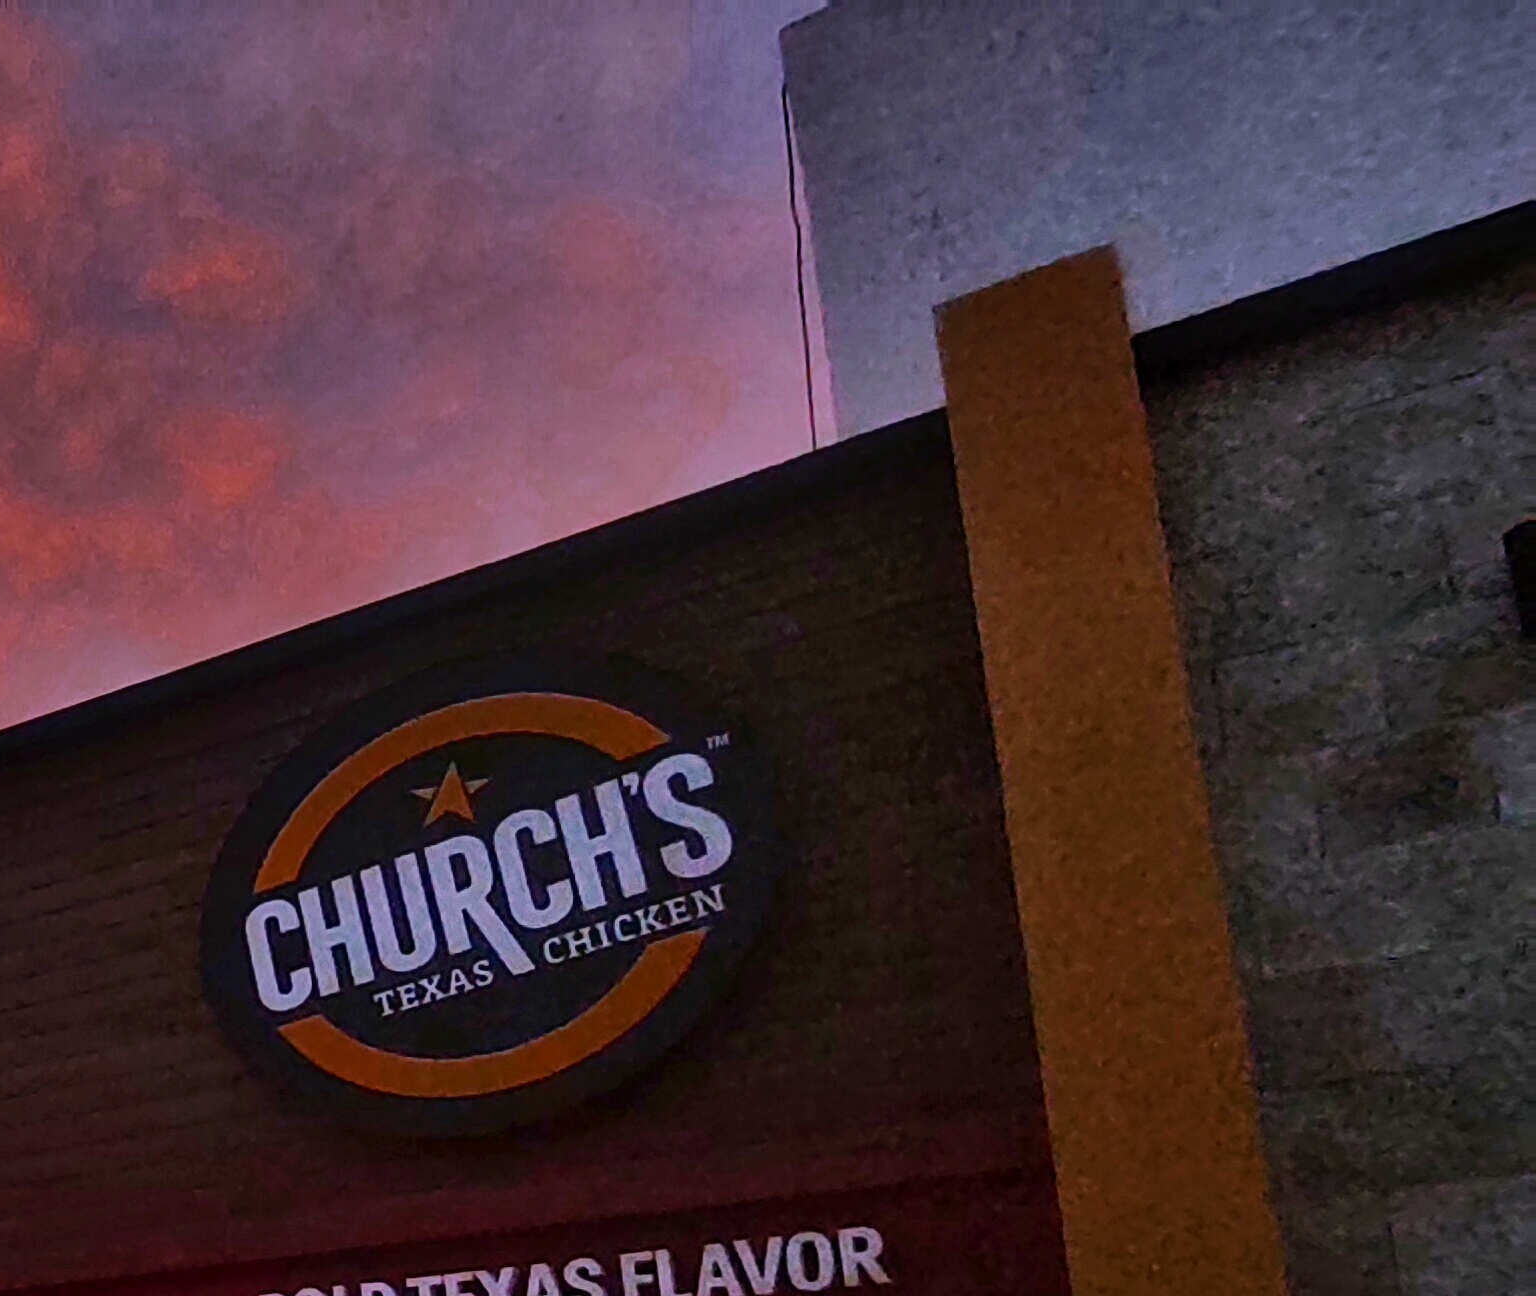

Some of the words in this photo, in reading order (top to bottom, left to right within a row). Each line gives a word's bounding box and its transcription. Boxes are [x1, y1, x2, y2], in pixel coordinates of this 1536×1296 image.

[243, 751, 736, 1014] CHURCH'S
[373, 959, 495, 1018] TEXAS
[542, 883, 728, 967] CHICKEN
